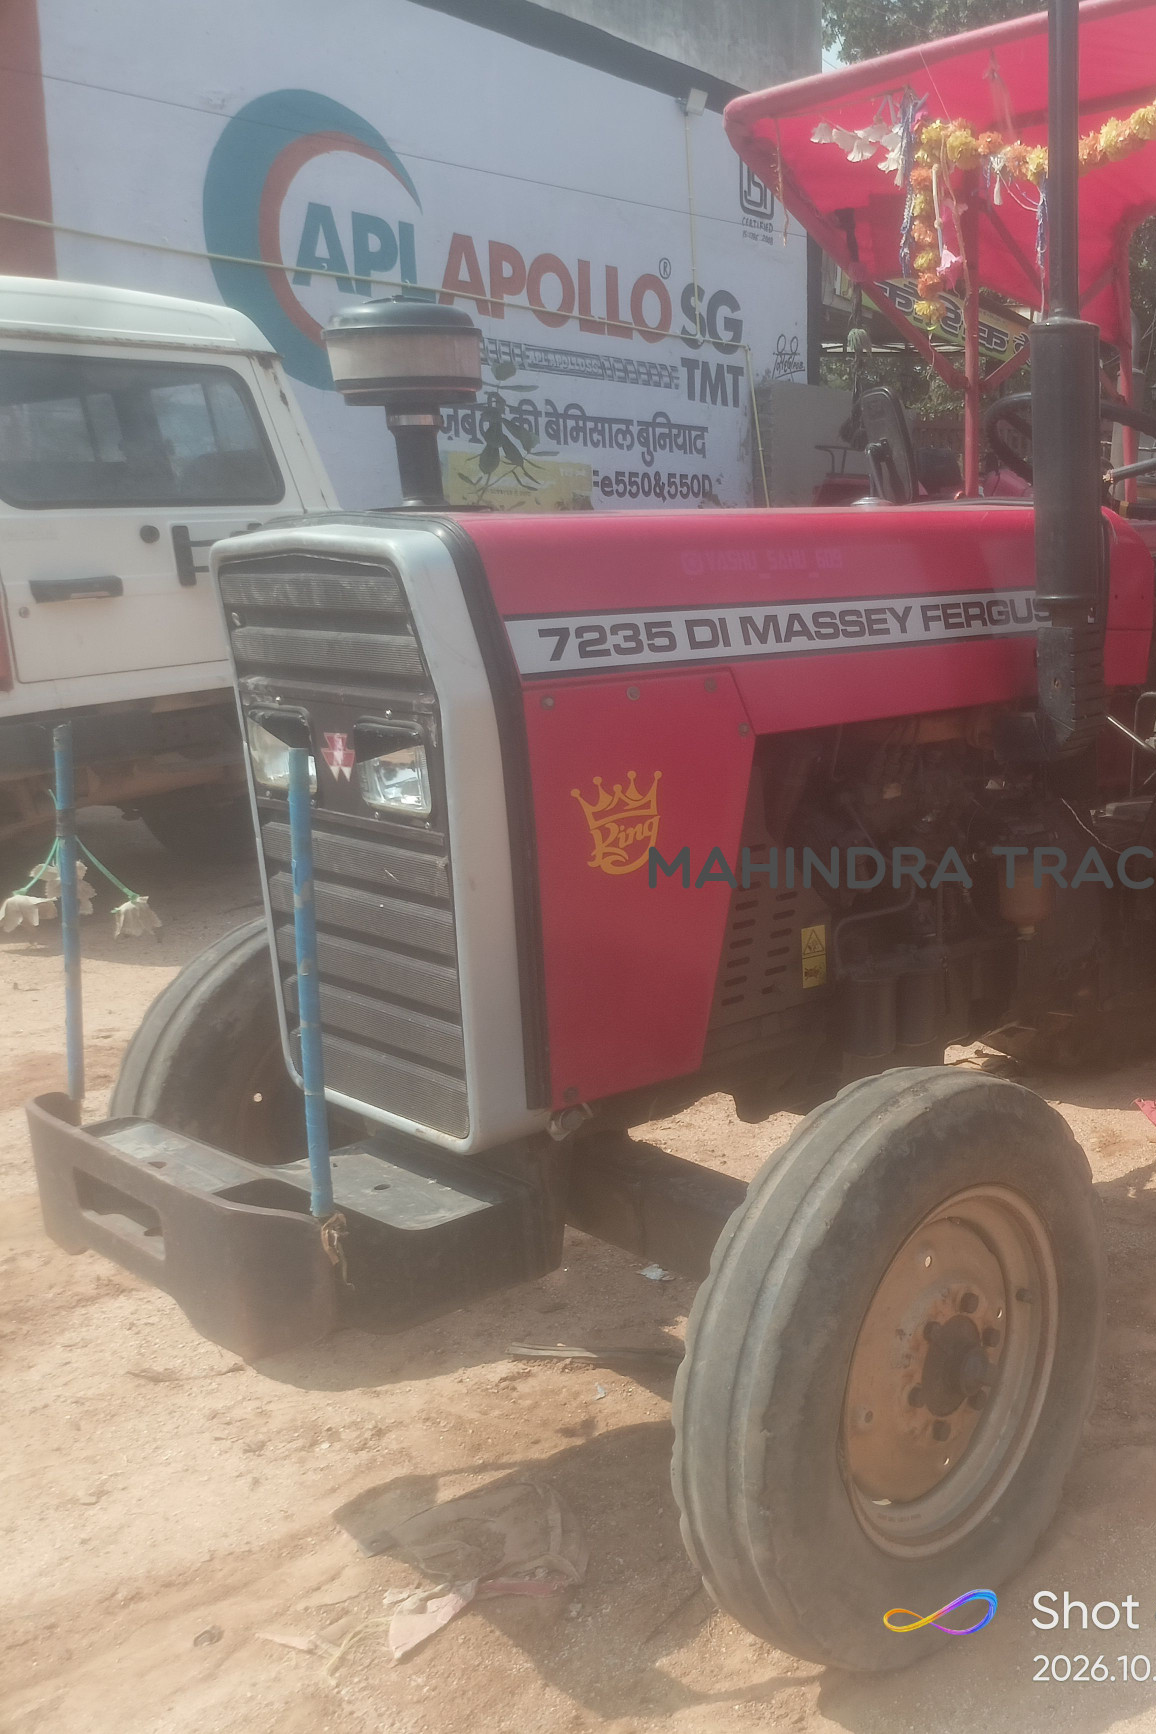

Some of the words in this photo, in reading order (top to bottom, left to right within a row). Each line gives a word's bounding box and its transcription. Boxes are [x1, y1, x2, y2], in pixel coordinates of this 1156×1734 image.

[438, 232, 672, 343] APOLLO
[680, 281, 744, 355] SG
[681, 357, 744, 408] TMT
[545, 399, 635, 451] बेमिसाल
[637, 411, 708, 467] बुनियाद
[538, 620, 678, 662] 7235
[686, 613, 731, 651] DI
[742, 605, 912, 646] MASSEY
